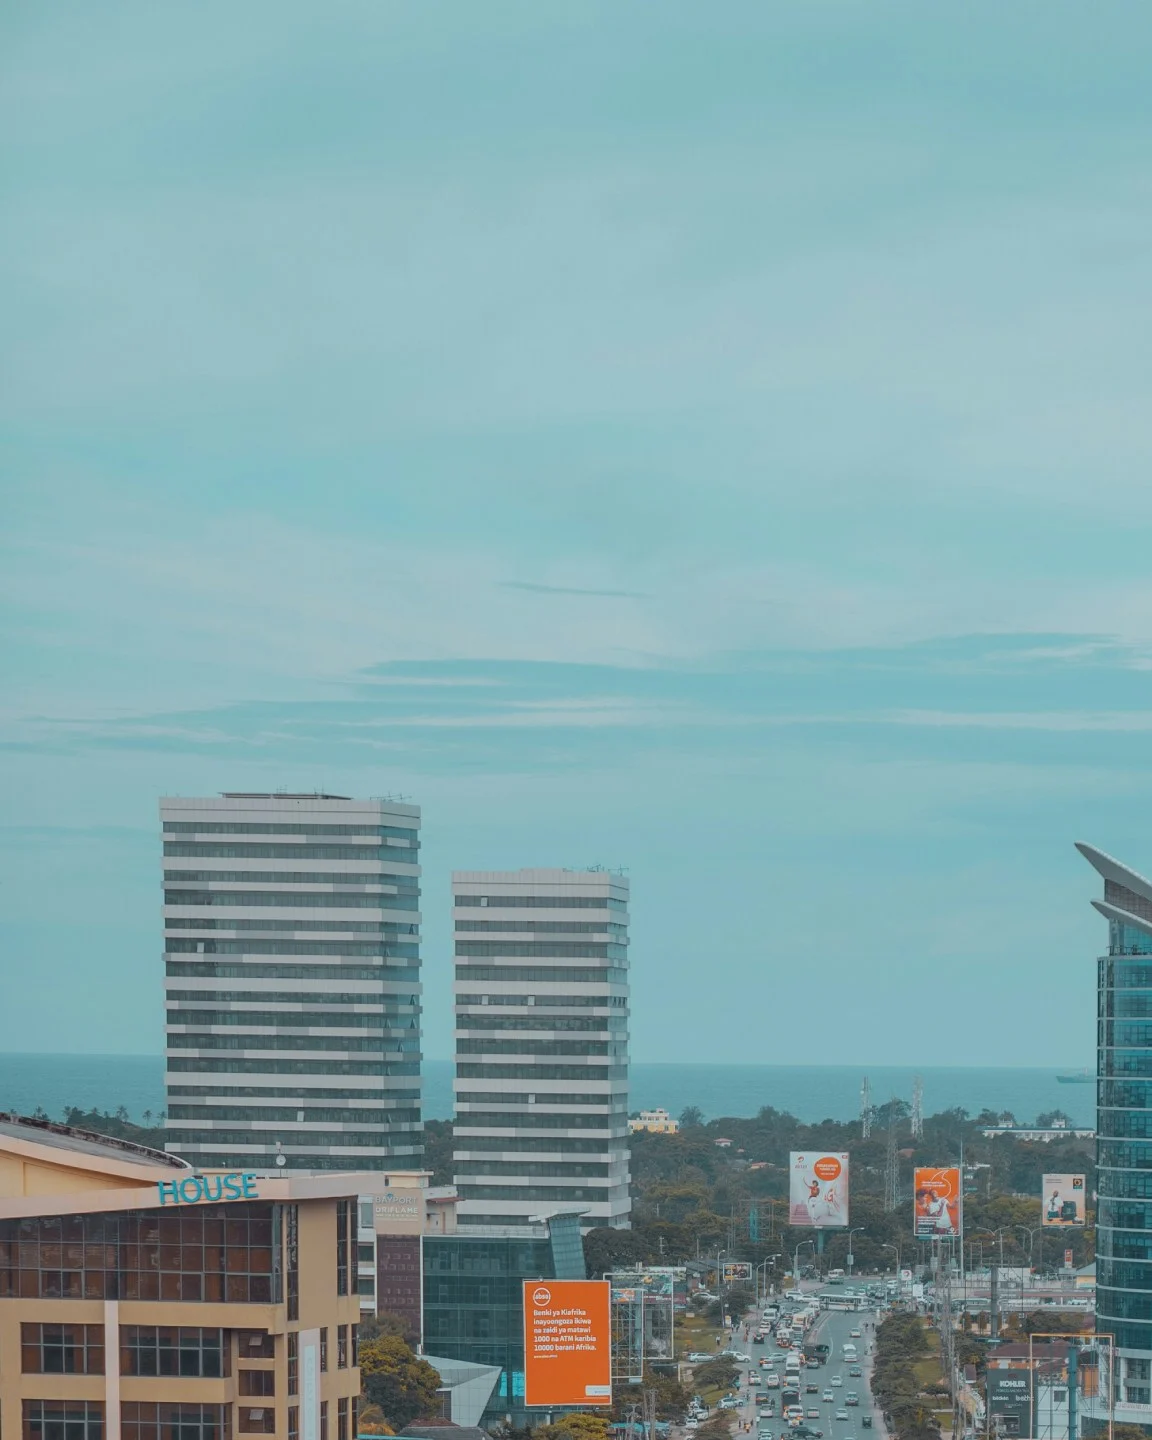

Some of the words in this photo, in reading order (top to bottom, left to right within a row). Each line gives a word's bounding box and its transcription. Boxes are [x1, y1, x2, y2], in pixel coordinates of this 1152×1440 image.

[158, 1173, 259, 1205] HOUSE
[375, 1196, 416, 1204] BAYPORT
[375, 1206, 419, 1214] ORIFLAME
[1000, 1380, 1026, 1388] KOHLER
